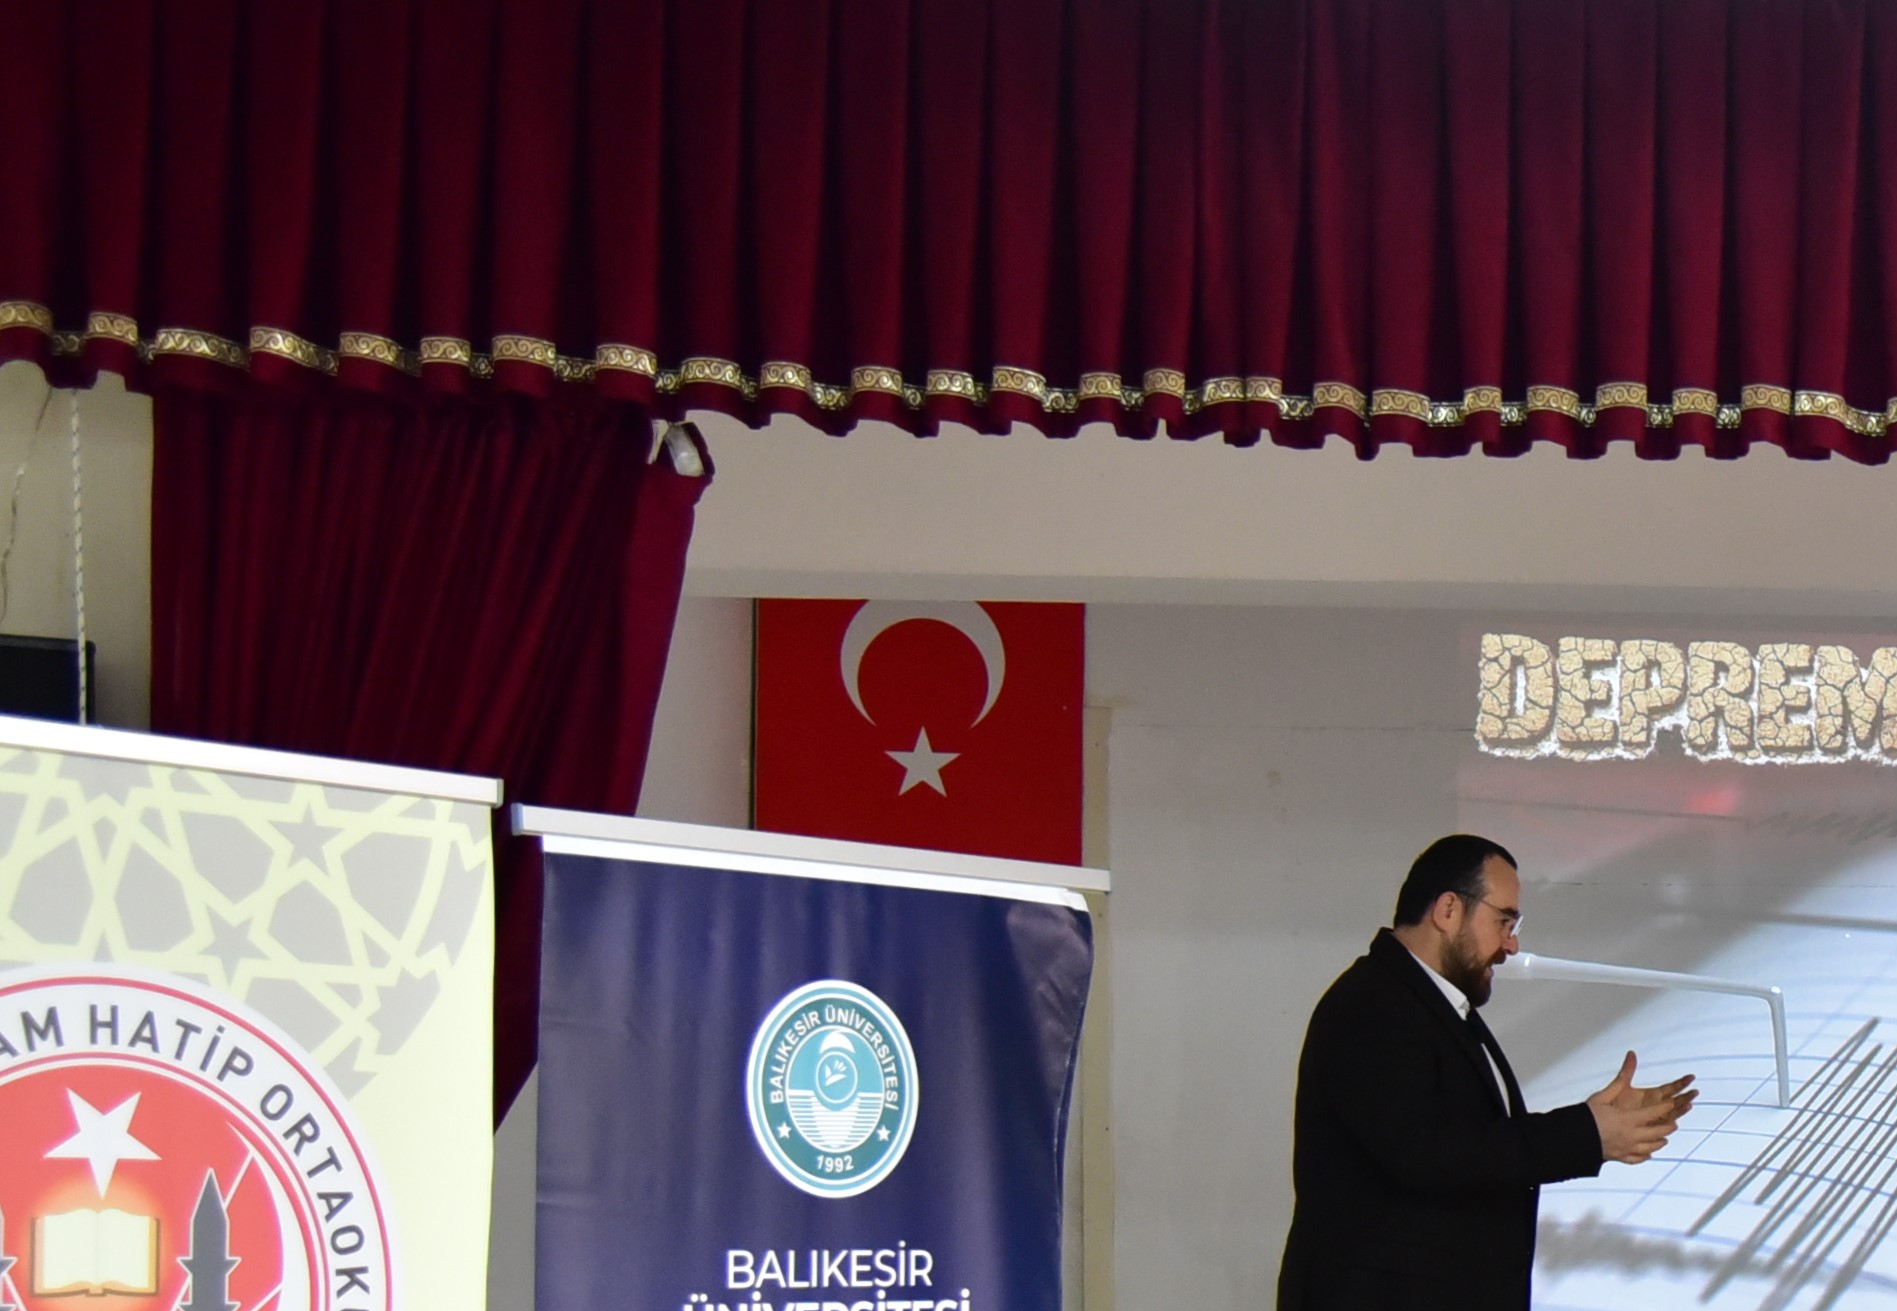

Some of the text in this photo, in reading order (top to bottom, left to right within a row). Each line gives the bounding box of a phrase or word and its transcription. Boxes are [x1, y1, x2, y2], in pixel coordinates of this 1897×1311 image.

[89, 1004, 255, 1082] HATİP
[770, 1005, 899, 1110] BALIKESİR ÜNİVERSİTESİ
[816, 1155, 855, 1173] 1992
[726, 1240, 933, 1289] BALIKESİR
